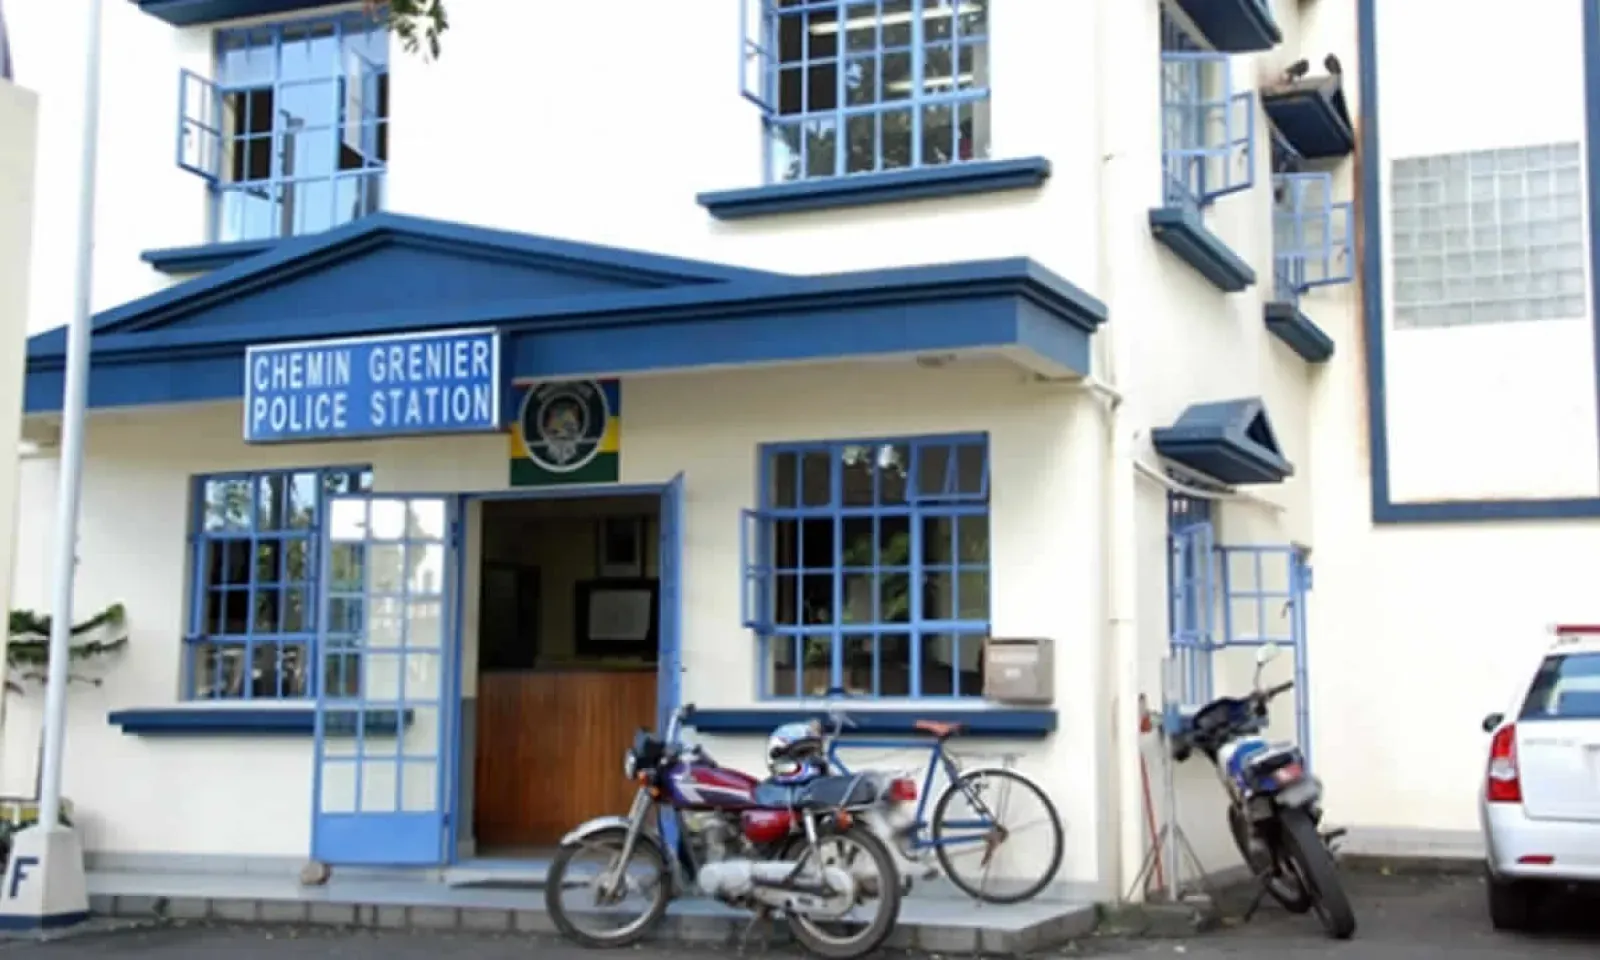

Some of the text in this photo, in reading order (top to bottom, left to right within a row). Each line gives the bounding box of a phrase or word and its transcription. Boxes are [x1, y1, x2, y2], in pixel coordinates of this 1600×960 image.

[254, 341, 489, 391] CHEMIN GRENIER
[254, 385, 489, 431] POLICE STATION
[9, 857, 39, 898] F
